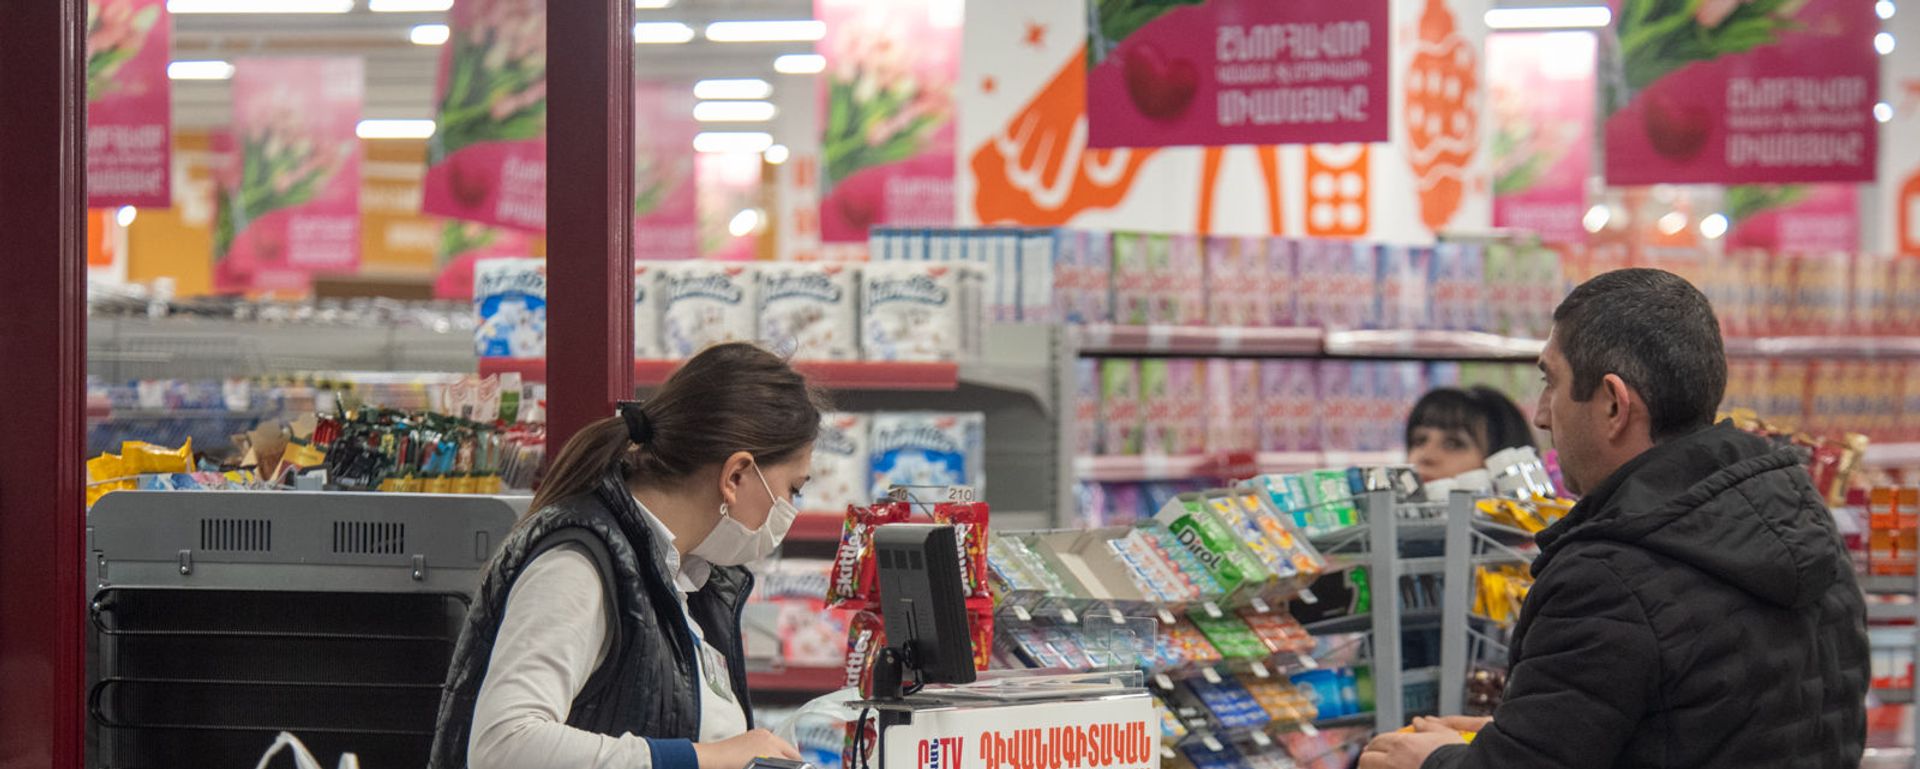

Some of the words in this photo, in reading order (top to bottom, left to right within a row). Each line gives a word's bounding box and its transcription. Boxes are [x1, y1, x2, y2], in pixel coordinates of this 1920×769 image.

[949, 488, 972, 500] 210
[836, 523, 867, 598] Skittles
[1177, 528, 1222, 570] Dirol
[980, 721, 1151, 769] ԴԻՎԱՆԱԳԻՏԱԿԱՆ
